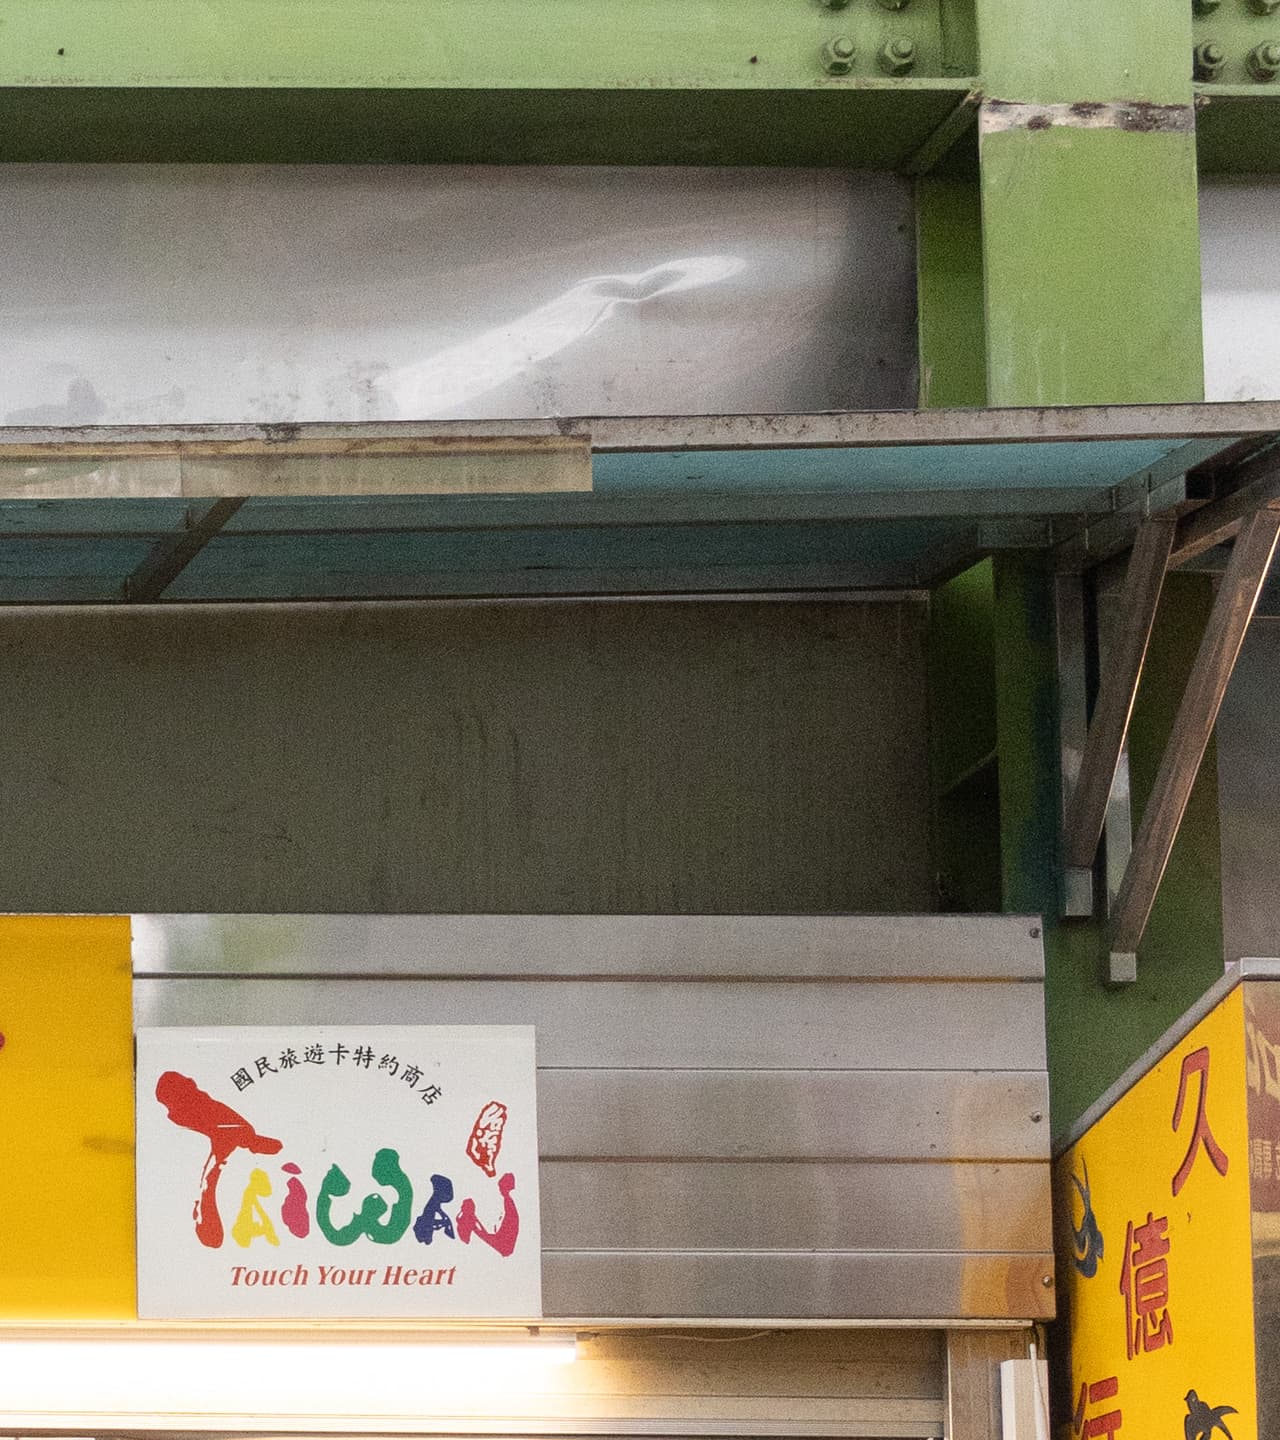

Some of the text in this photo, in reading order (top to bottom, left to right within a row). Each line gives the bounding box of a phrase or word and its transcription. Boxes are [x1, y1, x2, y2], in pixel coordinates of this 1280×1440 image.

[229, 1042, 444, 1107] 國民旅遊卡特約商店
[230, 1265, 457, 1287] Touch Your Heart
